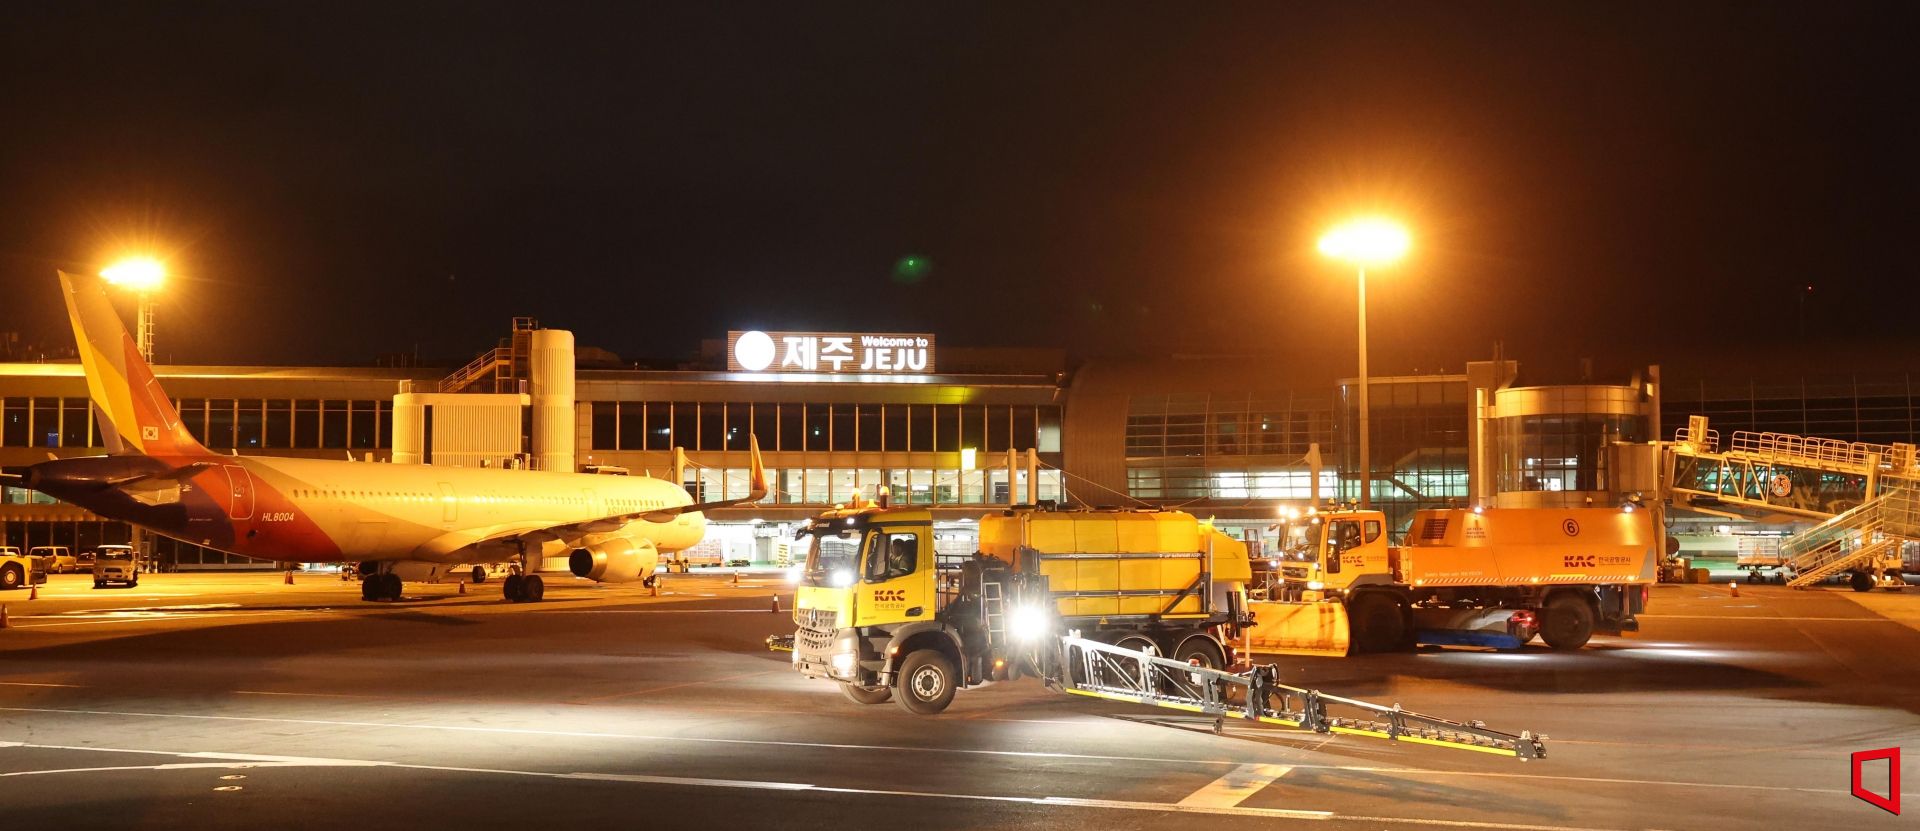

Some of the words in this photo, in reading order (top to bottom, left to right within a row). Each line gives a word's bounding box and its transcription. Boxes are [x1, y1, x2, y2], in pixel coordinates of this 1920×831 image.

[861, 335, 914, 347] Welcome
[915, 336, 928, 347] to
[782, 337, 853, 370] 제주
[860, 348, 927, 371] JEJU
[261, 512, 294, 521] HL8004
[1342, 555, 1362, 564] KAC
[1564, 555, 1595, 568] KAC
[874, 590, 905, 601] KAC
